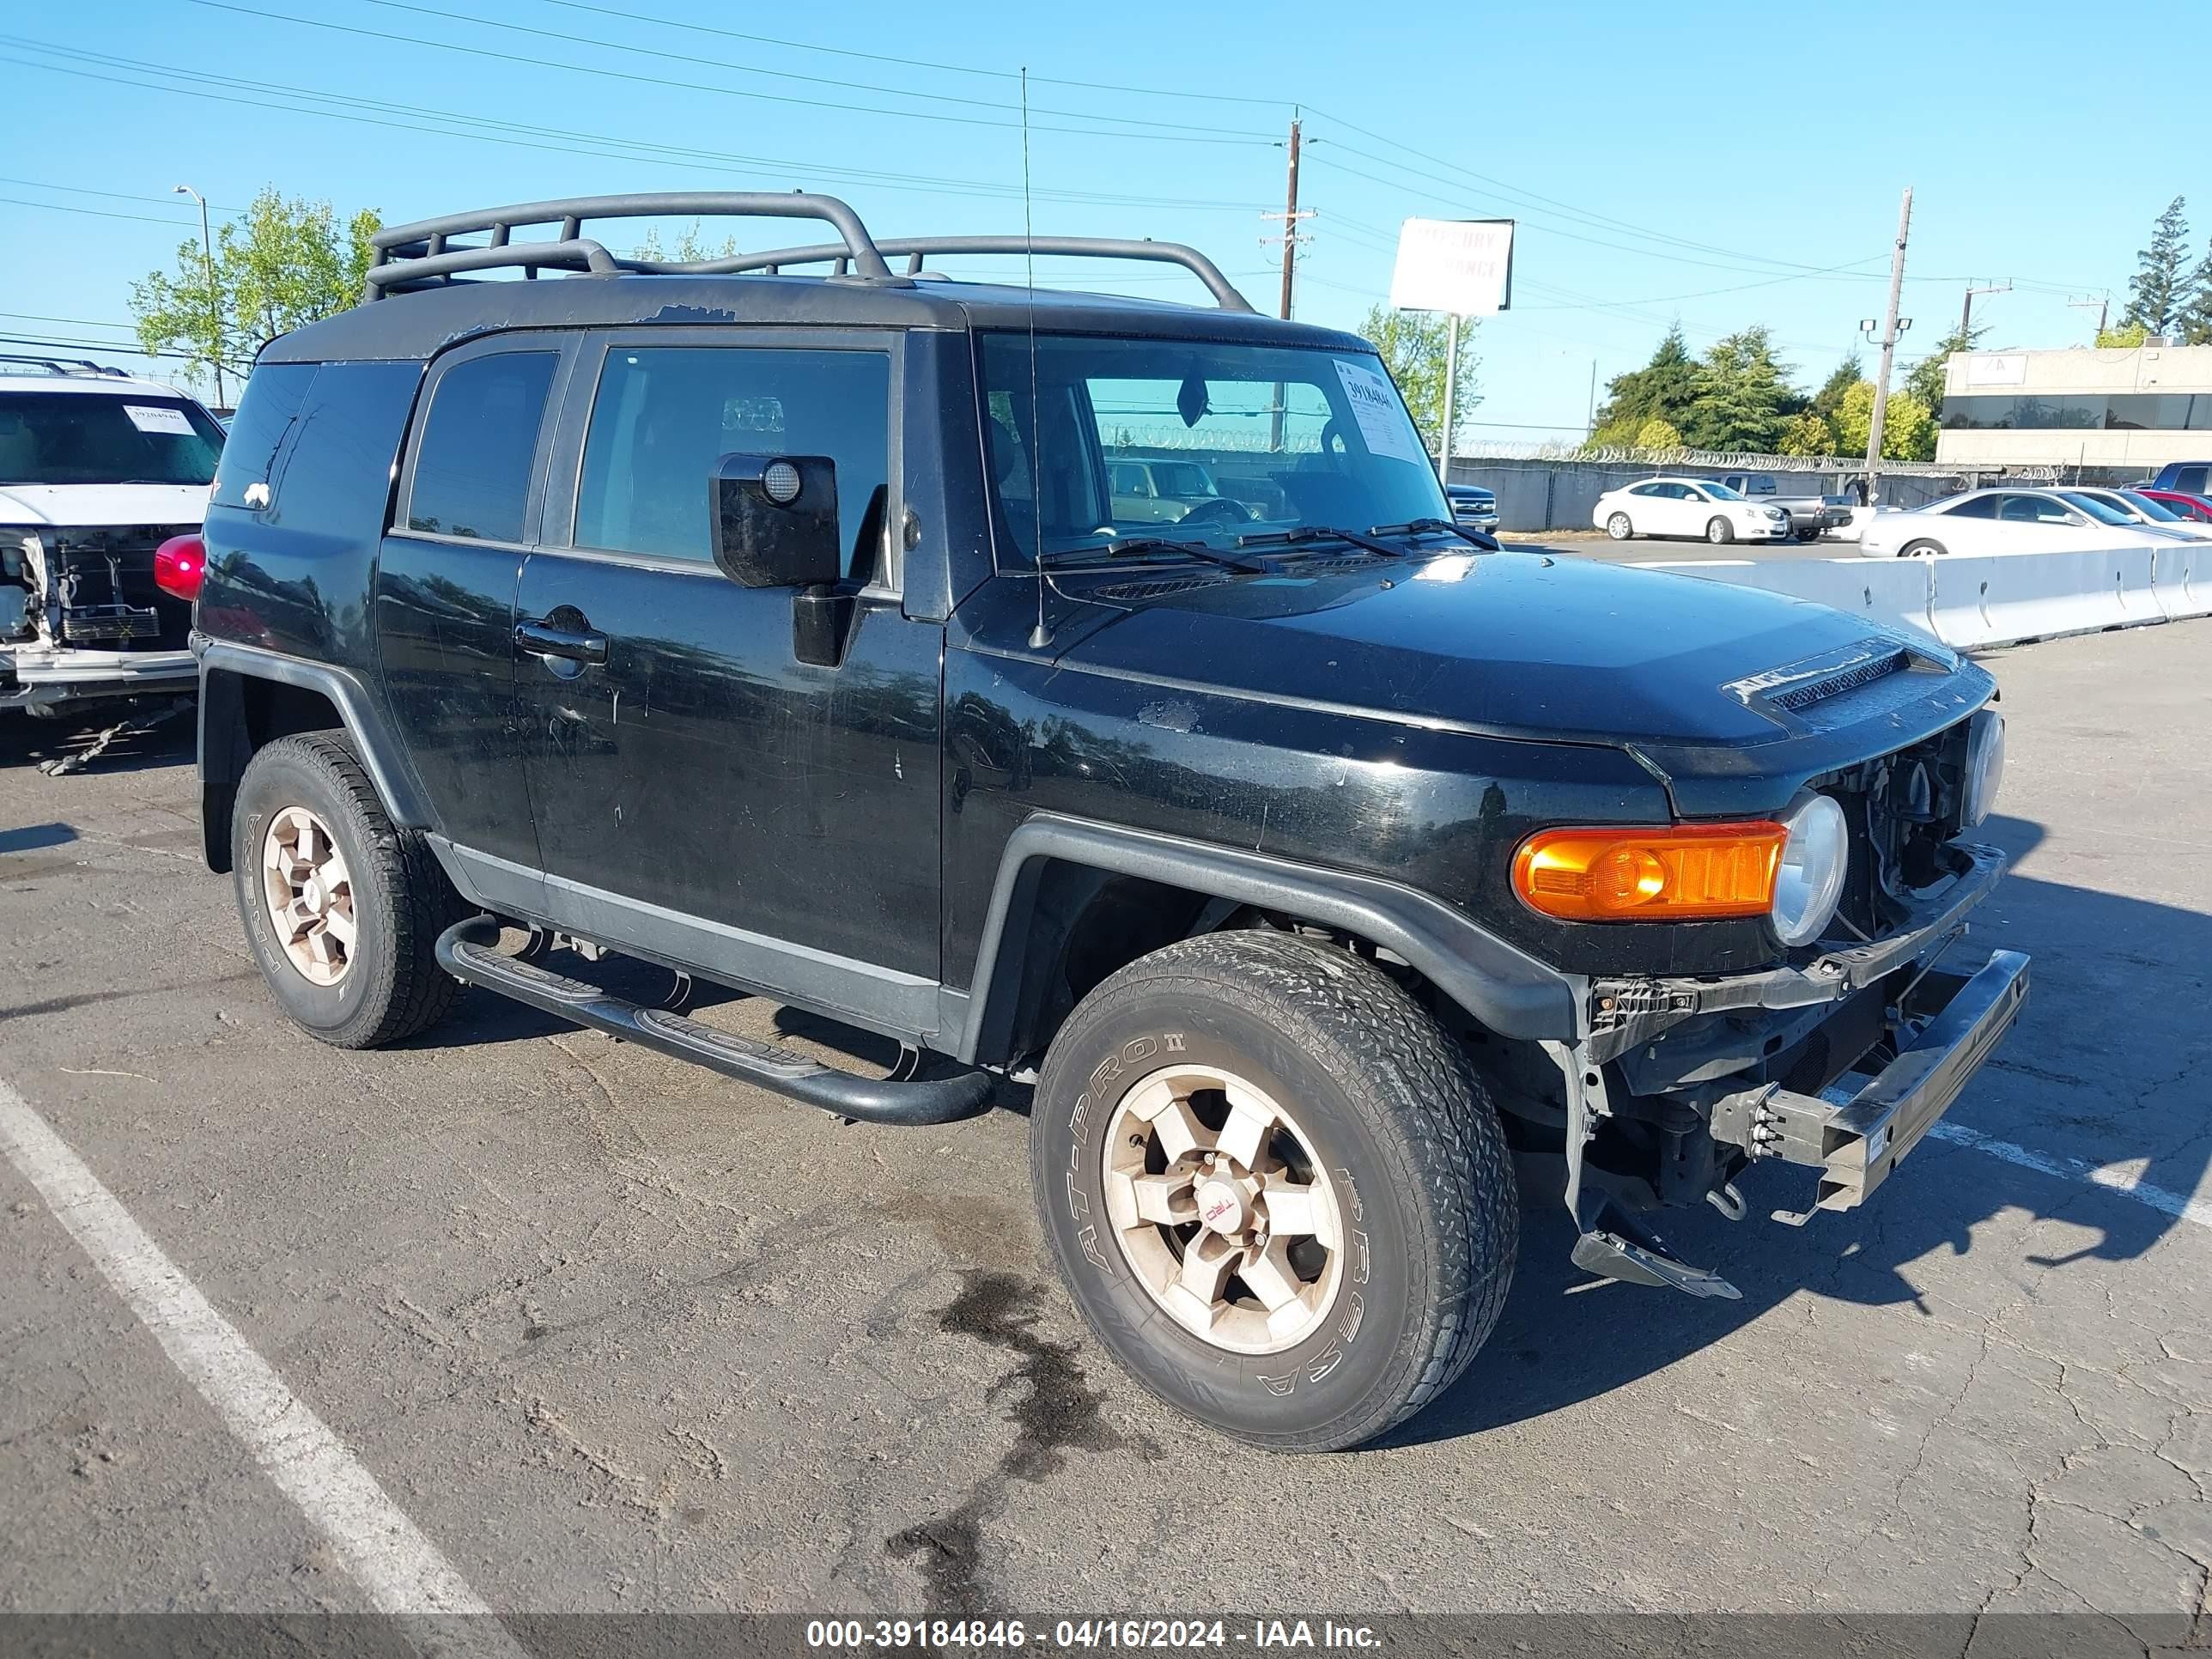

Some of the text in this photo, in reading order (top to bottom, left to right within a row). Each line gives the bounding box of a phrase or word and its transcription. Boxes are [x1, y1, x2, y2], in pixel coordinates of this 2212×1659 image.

[1347, 381, 1394, 410] 39184846
[242, 814, 282, 974] PRESA
[1205, 1199, 1235, 1221] TRD
[1255, 1165, 1369, 1398] PRESA
